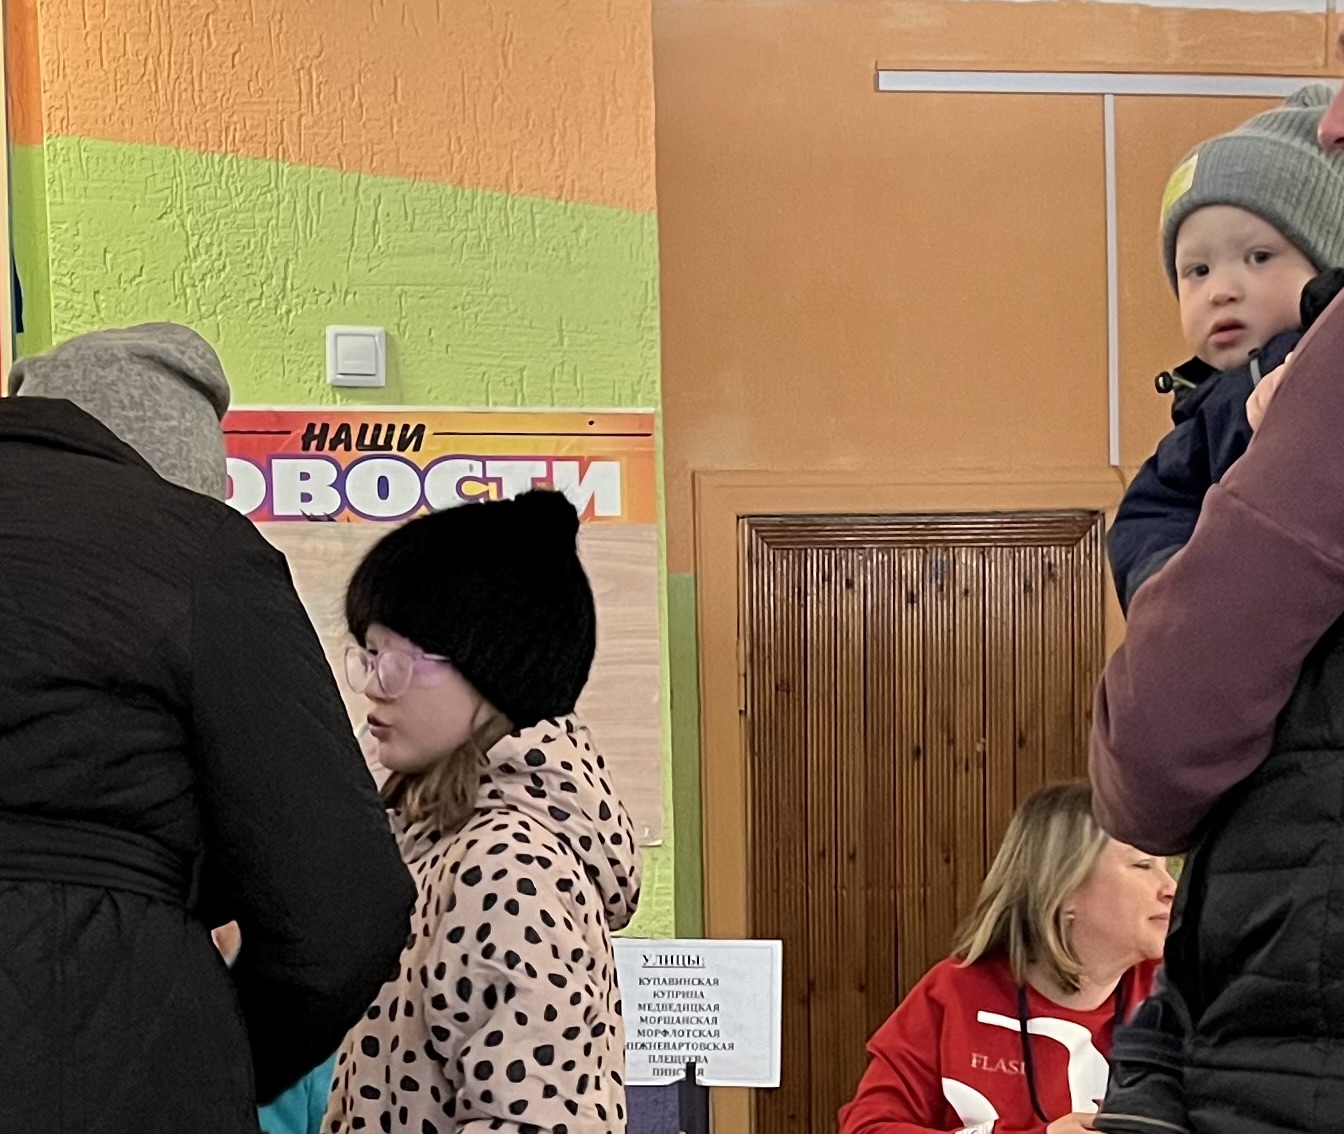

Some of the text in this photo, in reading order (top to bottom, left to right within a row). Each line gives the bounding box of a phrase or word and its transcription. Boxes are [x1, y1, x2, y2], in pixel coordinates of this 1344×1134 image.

[301, 423, 426, 452] НАШИ
[639, 977, 720, 987] КУПАВИНСКАЯ
[653, 990, 705, 999] КУПРИНА
[638, 1003, 720, 1013] МЕДВЕДИЦКАЯ
[639, 1016, 718, 1025] МОРШАНСКАЯ
[637, 1029, 720, 1038] МОРФЛОТСКАЯ
[652, 1068, 704, 1077] ПИНСЯ
